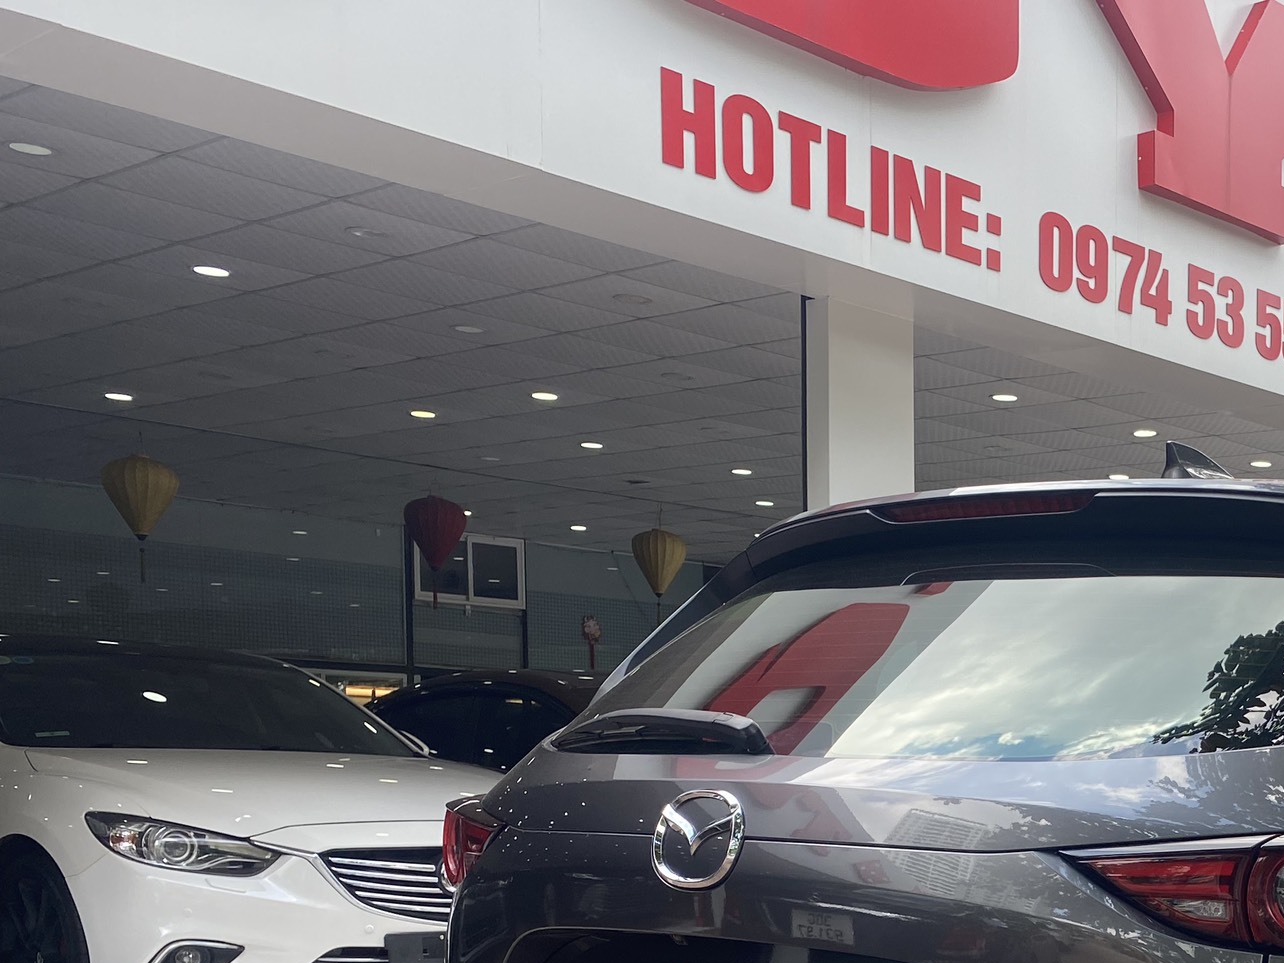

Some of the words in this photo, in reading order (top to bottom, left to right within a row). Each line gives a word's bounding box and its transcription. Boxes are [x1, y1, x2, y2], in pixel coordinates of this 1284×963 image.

[660, 66, 1001, 272] HOTLINE:
[1038, 211, 1173, 327] 0974
[1187, 263, 1245, 349] 53
